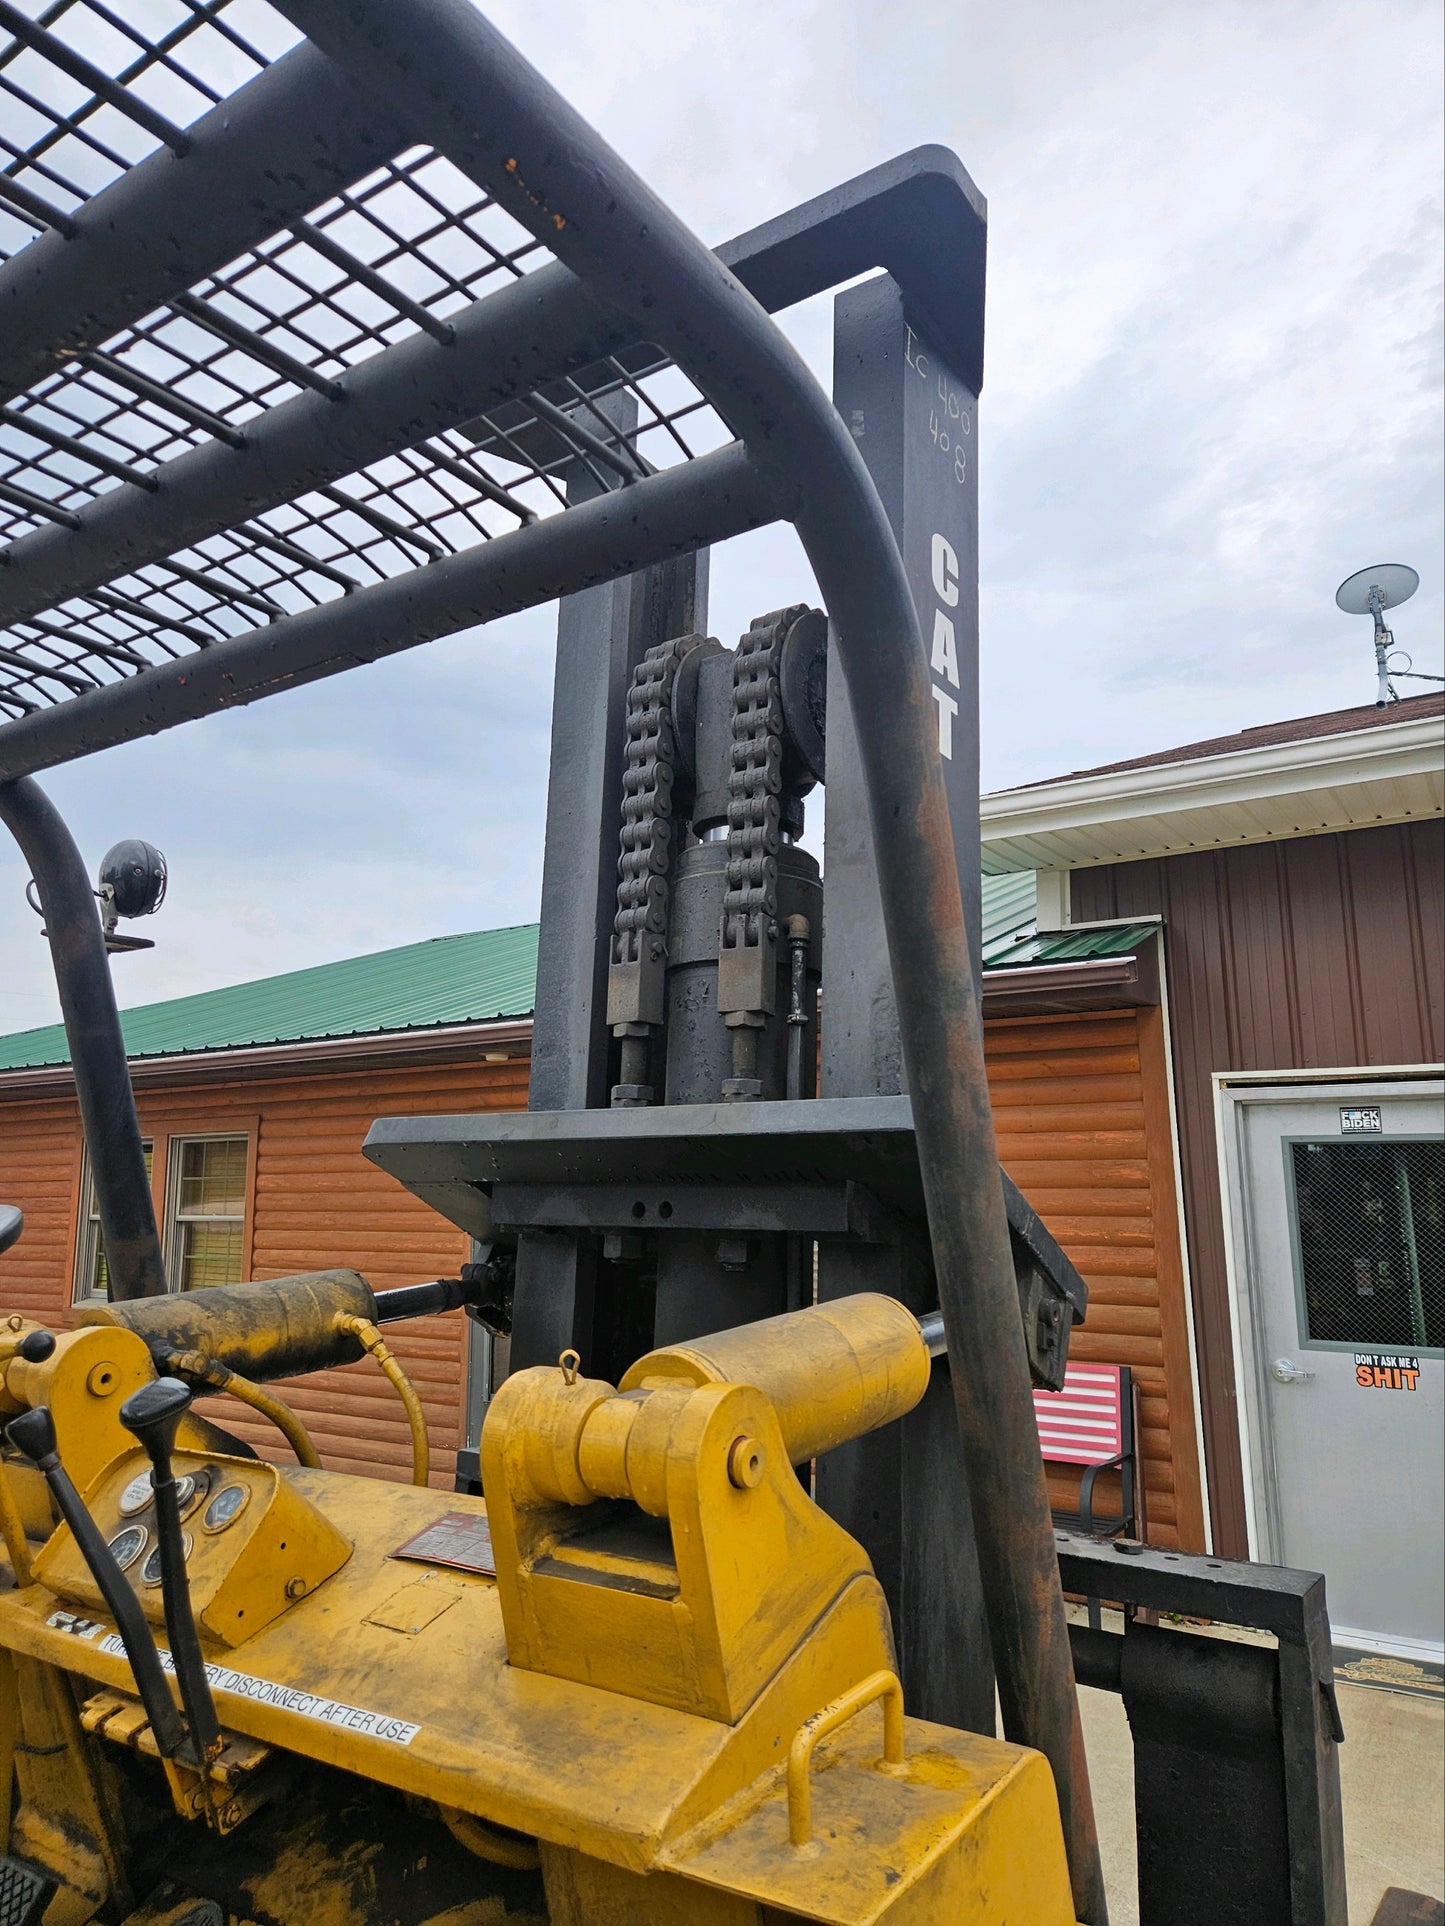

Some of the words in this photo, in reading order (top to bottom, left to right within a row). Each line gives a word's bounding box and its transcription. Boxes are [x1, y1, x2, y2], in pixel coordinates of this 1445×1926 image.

[931, 533, 960, 760] CAT
[1342, 1111, 1378, 1119] FCK
[1343, 1119, 1380, 1127] BIDEN
[1356, 1354, 1379, 1365] DONT
[1381, 1356, 1397, 1367] ASK
[1398, 1357, 1411, 1369] ME
[1412, 1358, 1418, 1369] 4
[1357, 1365, 1419, 1390] SHIT
[223, 1673, 321, 1714] DISCONNECT
[319, 1703, 376, 1731] AFTER
[375, 1718, 416, 1742] USE
